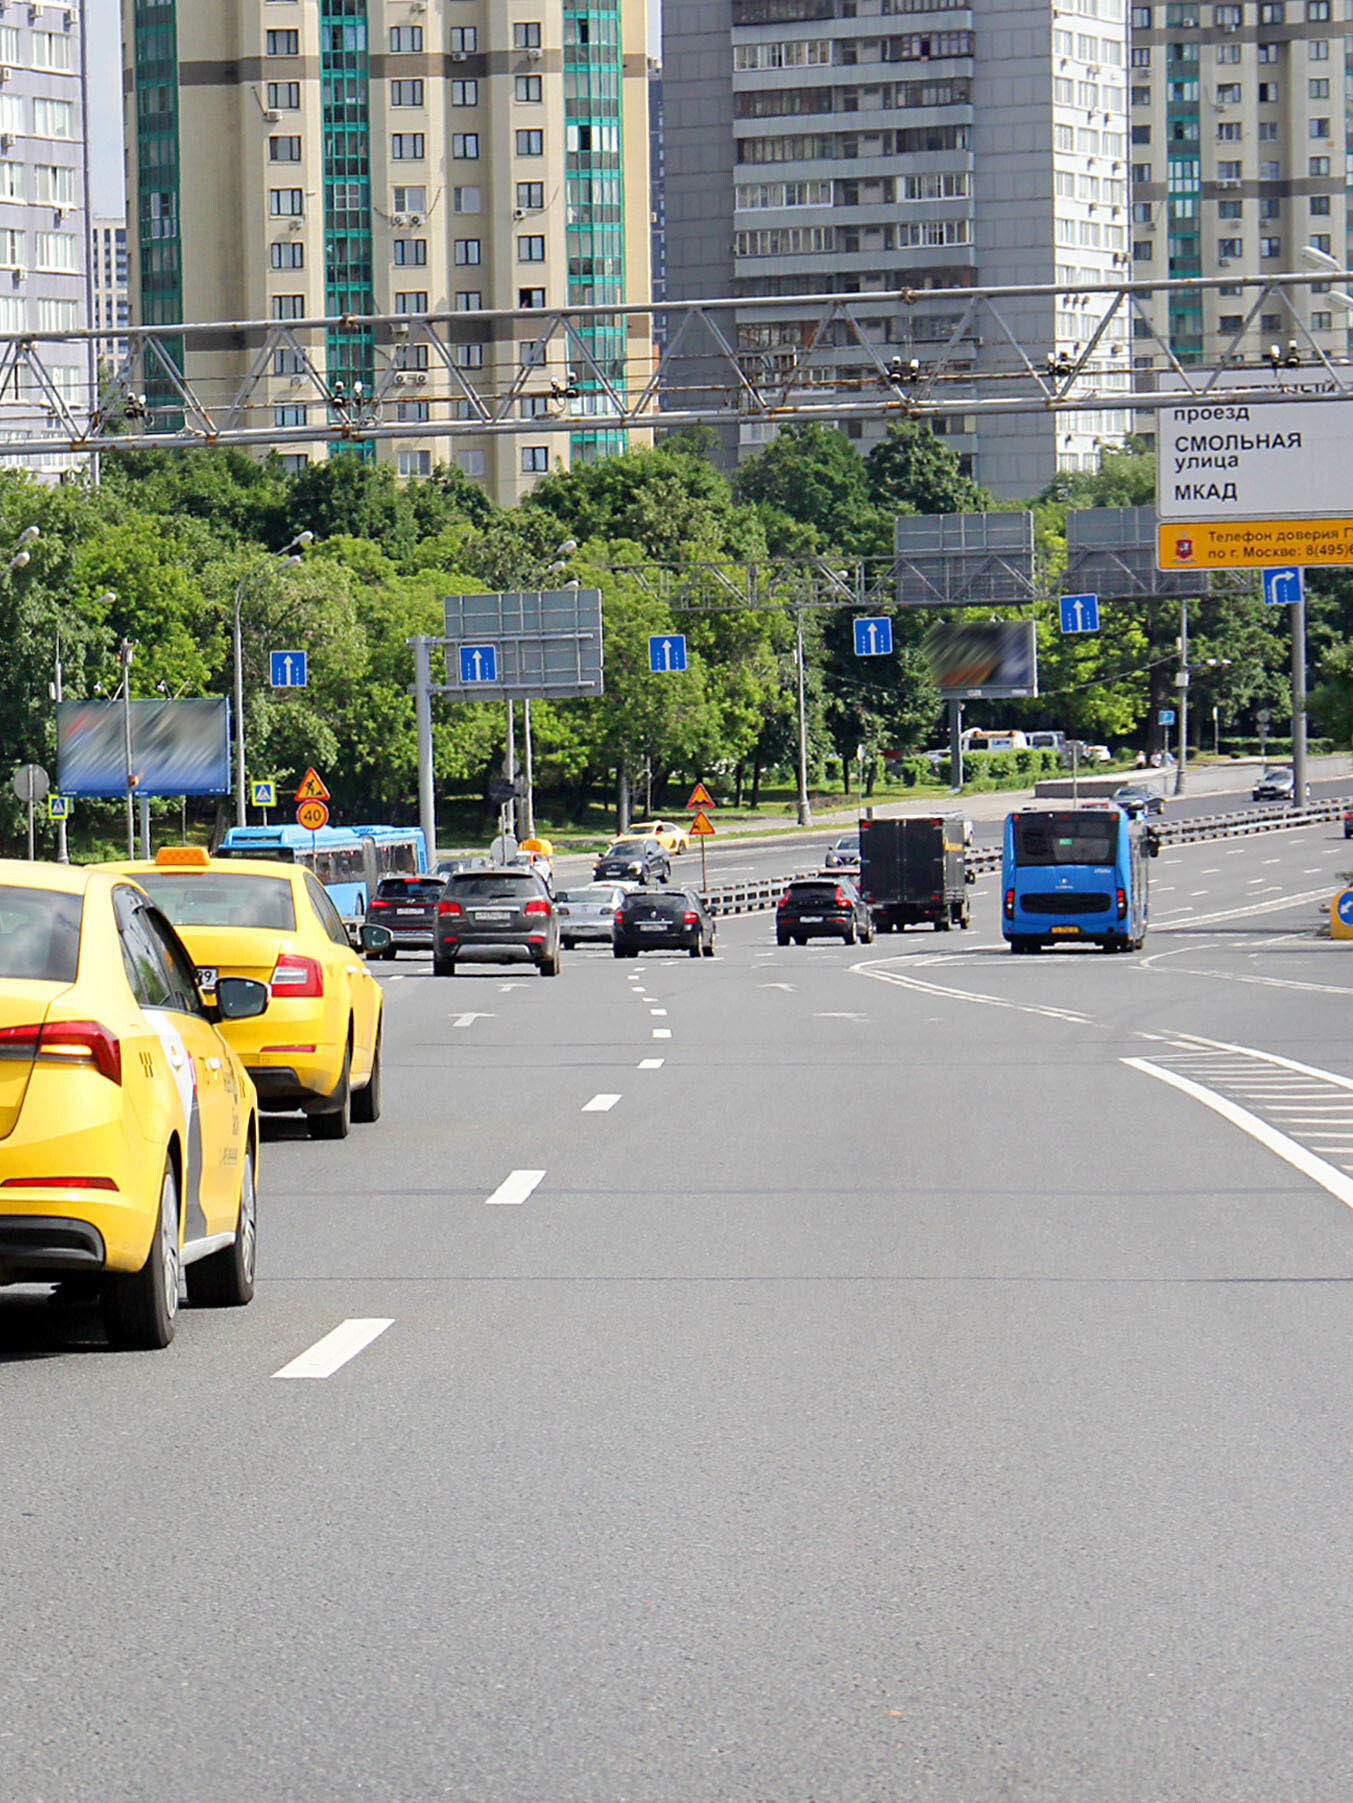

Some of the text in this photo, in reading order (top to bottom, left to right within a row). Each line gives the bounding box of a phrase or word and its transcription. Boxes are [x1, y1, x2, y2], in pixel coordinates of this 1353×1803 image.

[1174, 407, 1250, 424] проезд
[1175, 432, 1302, 452] СМОЛЬНАЯ
[1175, 455, 1239, 473] улица
[1175, 483, 1238, 501] МКАД
[1209, 530, 1272, 544] Телефон
[1276, 527, 1339, 543] доверия
[1208, 550, 1226, 562] по
[1230, 549, 1239, 559] г.
[1243, 545, 1302, 559] Москве:
[303, 810, 322, 822] 40
